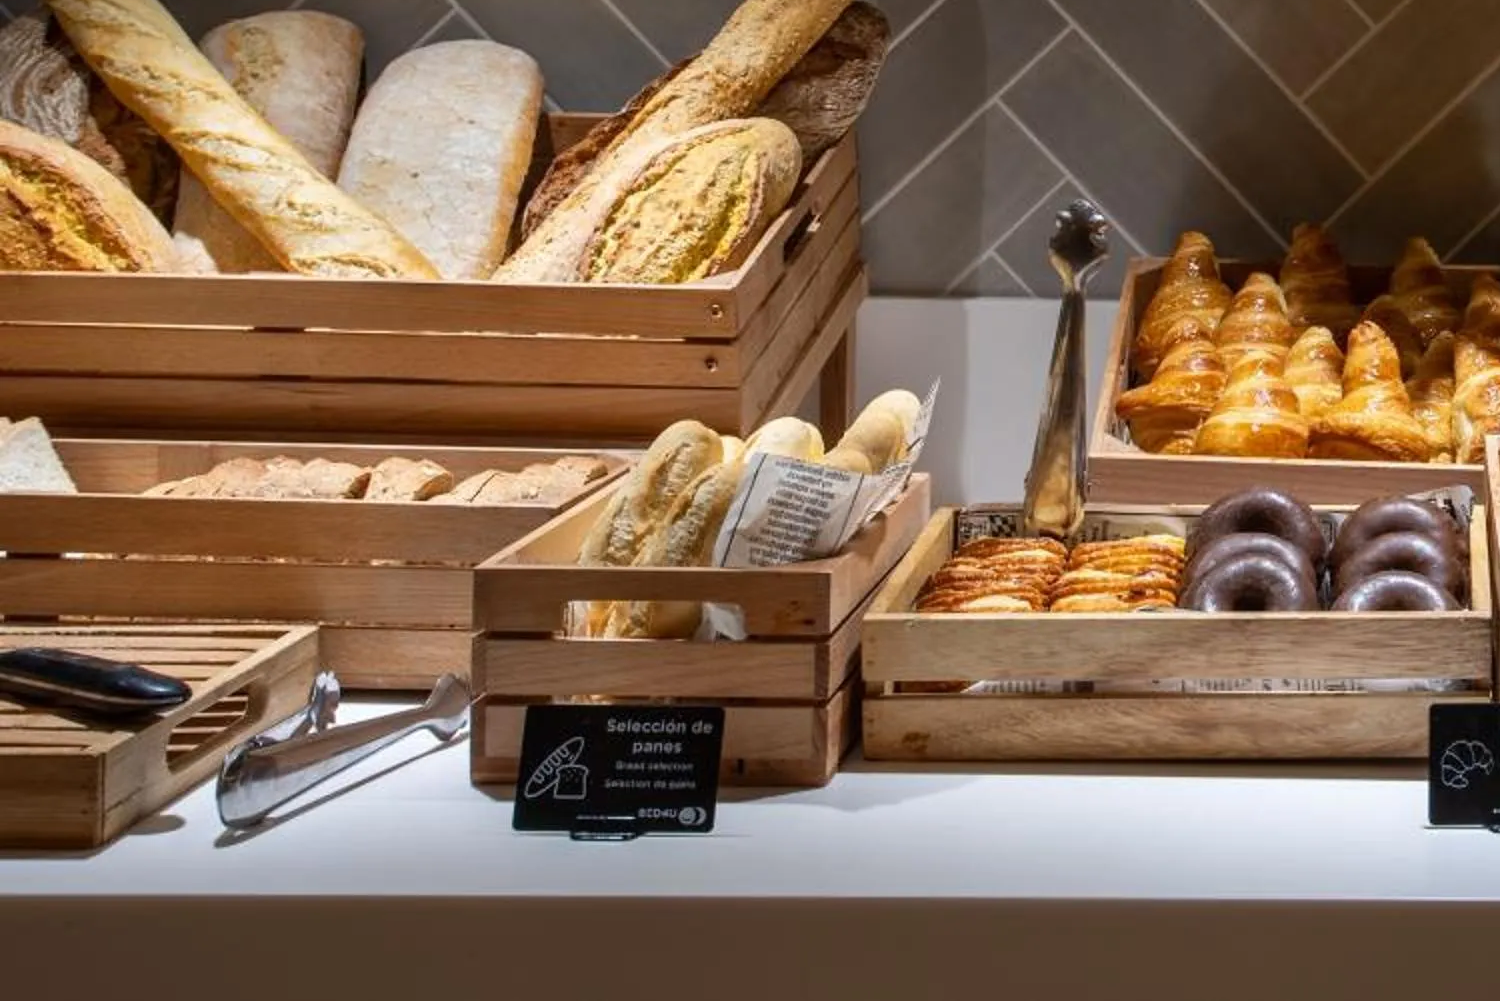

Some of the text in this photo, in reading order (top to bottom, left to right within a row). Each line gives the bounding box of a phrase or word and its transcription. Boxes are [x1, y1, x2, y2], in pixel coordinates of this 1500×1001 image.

[606, 718, 714, 735] Selección de
[632, 740, 683, 755] panes
